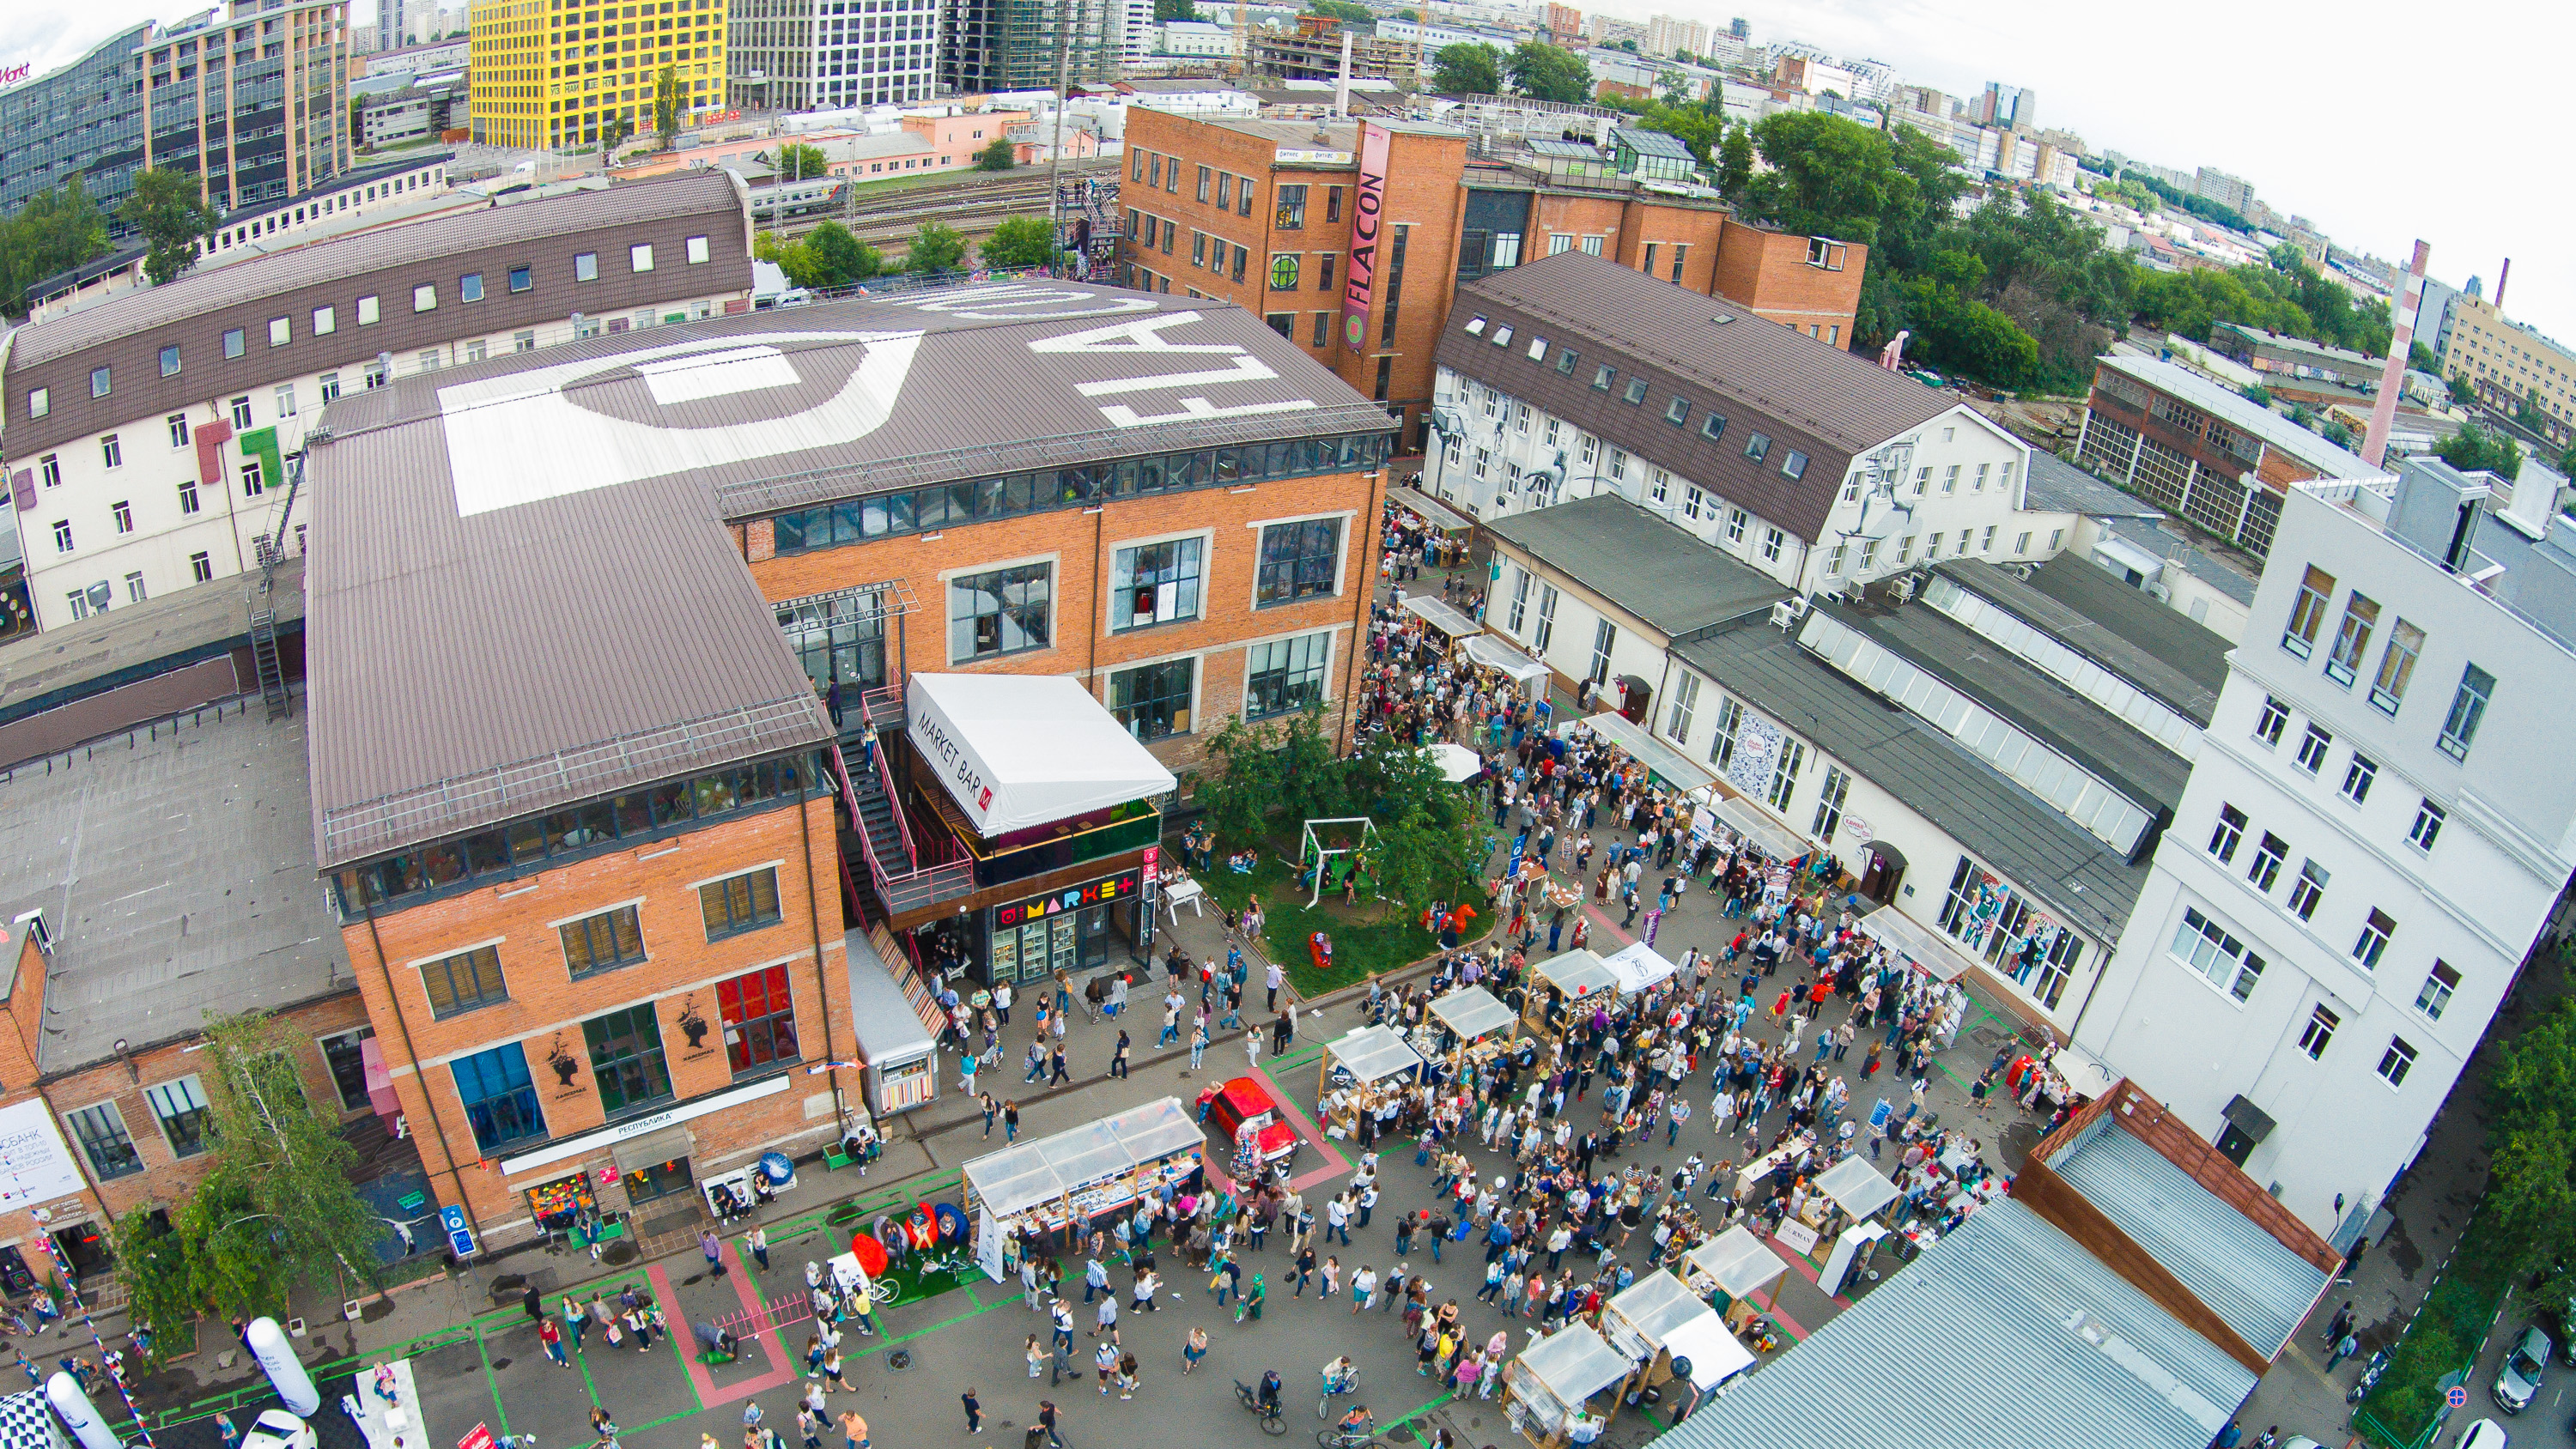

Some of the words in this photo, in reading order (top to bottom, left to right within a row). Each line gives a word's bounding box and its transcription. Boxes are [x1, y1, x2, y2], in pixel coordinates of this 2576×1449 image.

[1348, 173, 1382, 305] FLACON
[918, 710, 959, 767] MARKET
[957, 760, 981, 798] BAR
[1028, 877, 1133, 919] MARKET
[618, 1113, 671, 1134] РЕСПУБЛИКА
[0, 1129, 42, 1150] СБАНК
[23, 1139, 47, 1151] ТОП-10
[1783, 1225, 1812, 1243] GURMAN
